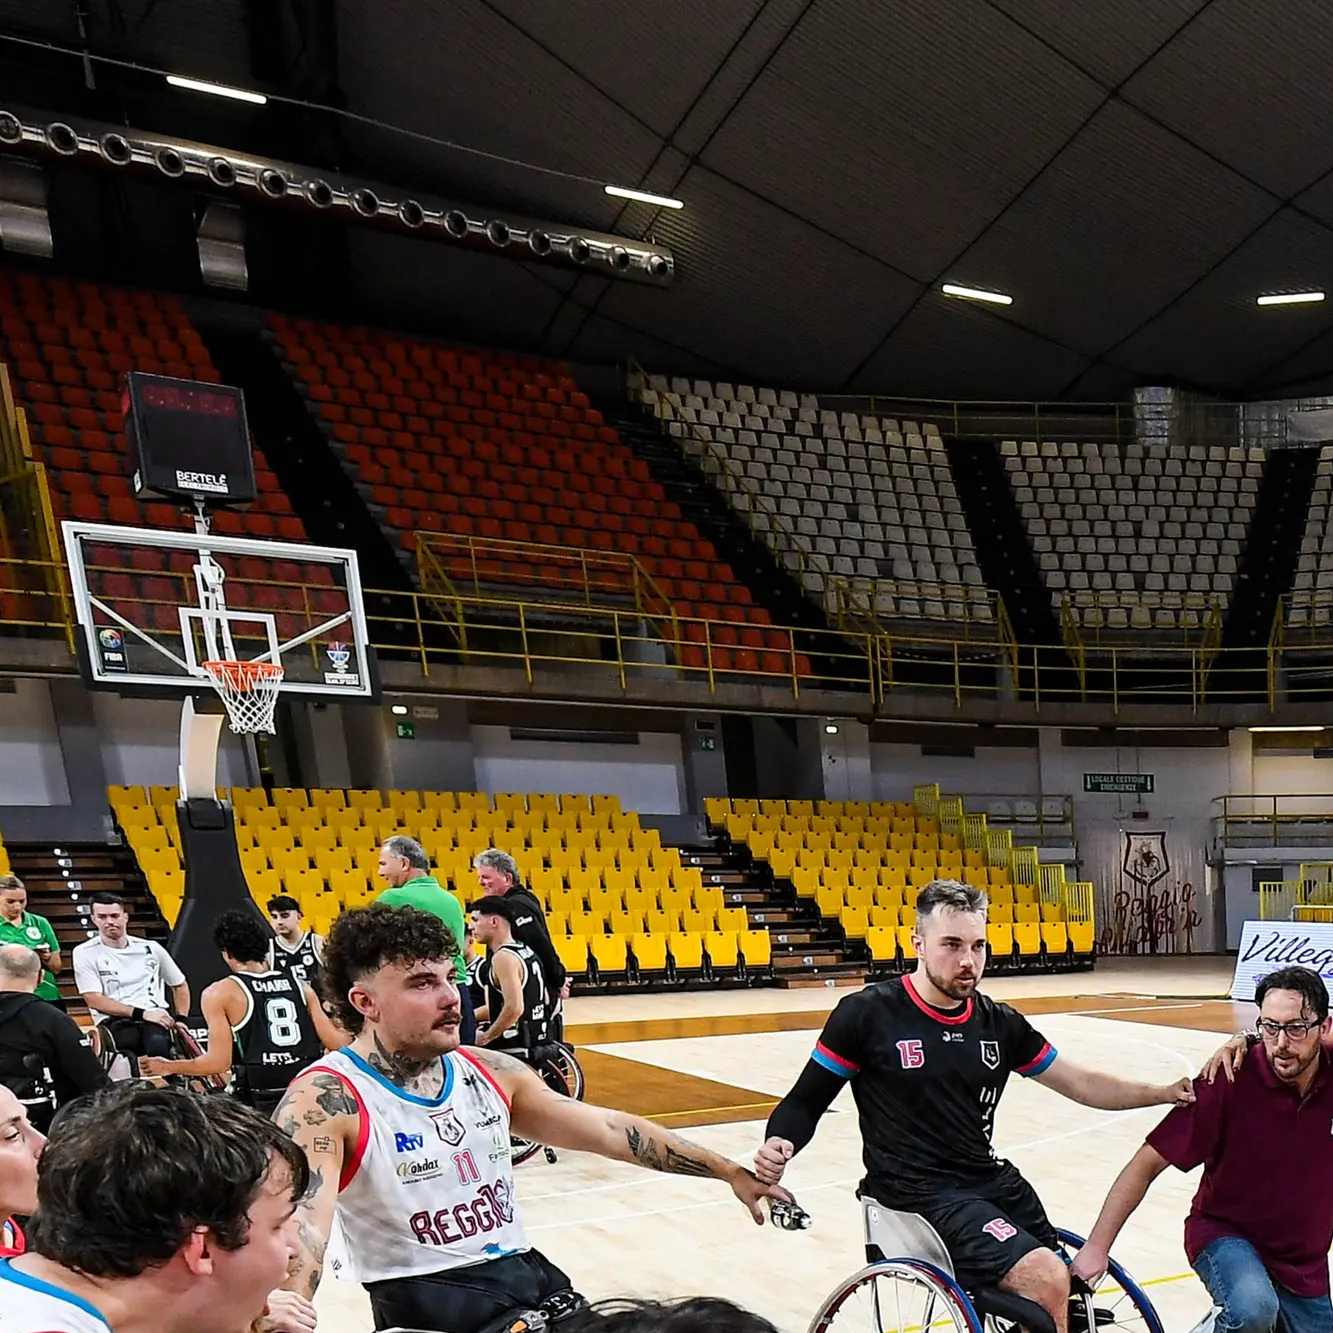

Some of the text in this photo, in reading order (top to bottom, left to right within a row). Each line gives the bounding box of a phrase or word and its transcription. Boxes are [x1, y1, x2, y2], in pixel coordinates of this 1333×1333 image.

[266, 997, 302, 1047] 8
[895, 1039, 925, 1069] 15
[452, 1148, 482, 1186] 11
[982, 1218, 1017, 1242] 15
